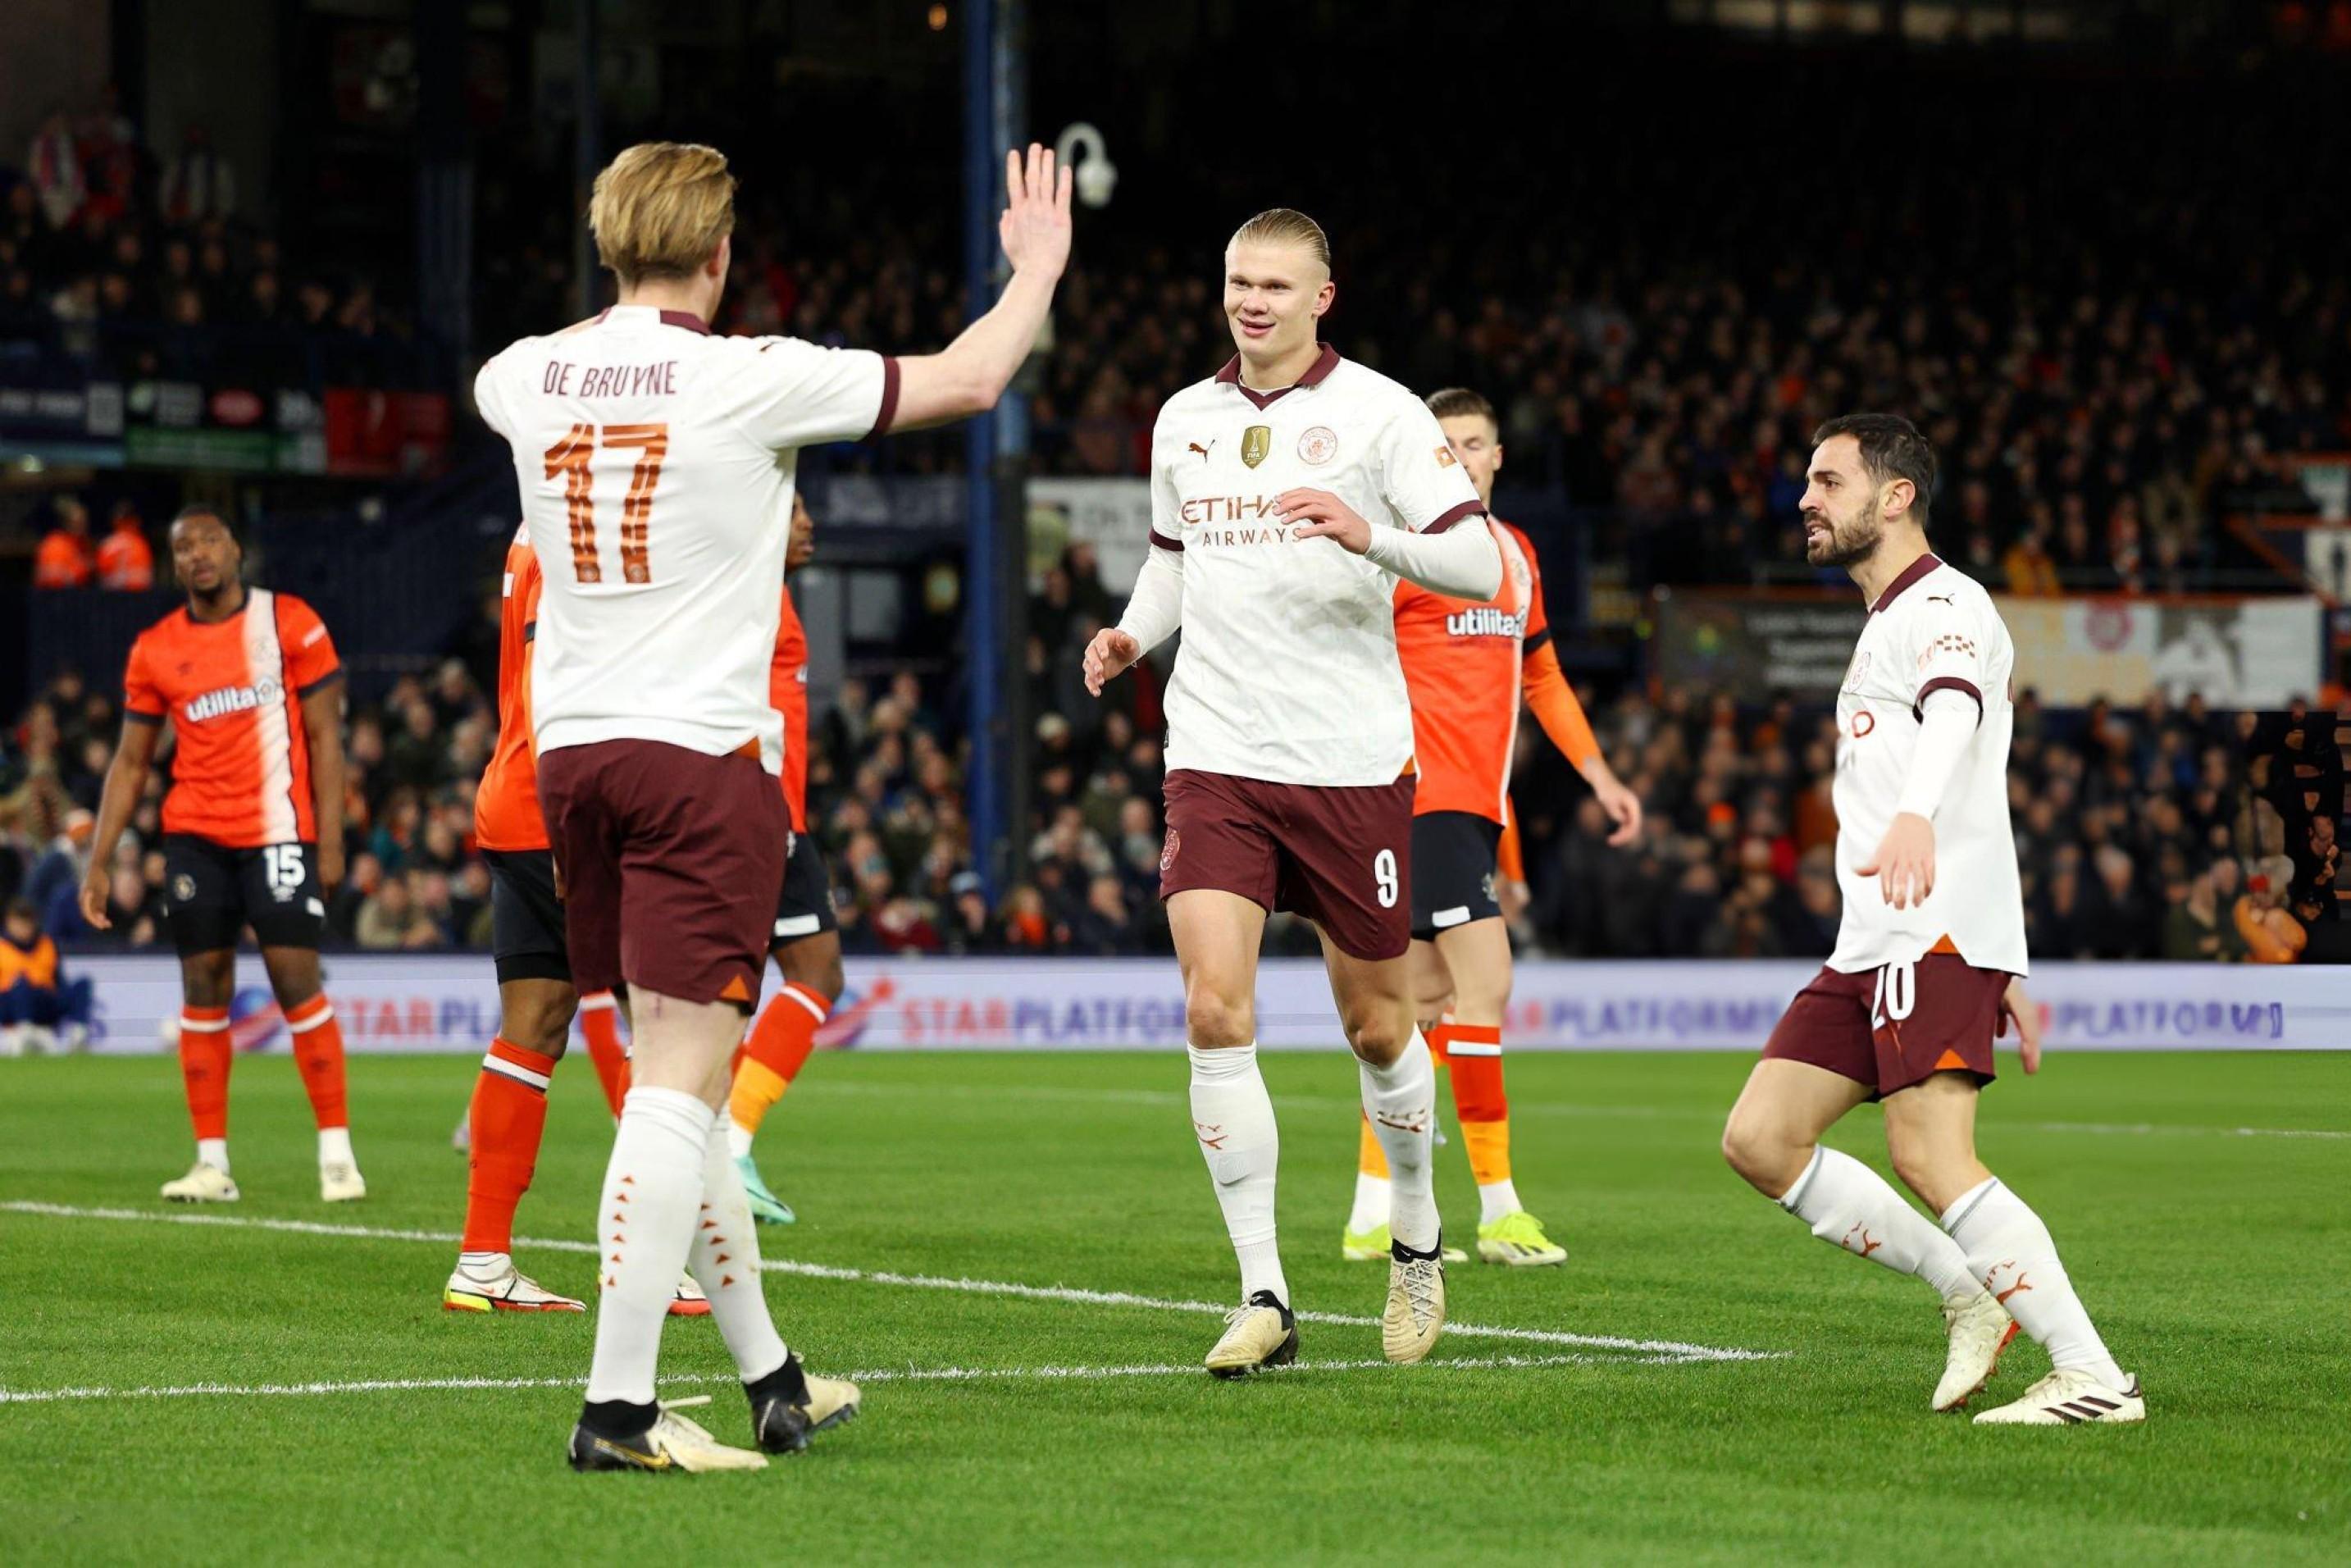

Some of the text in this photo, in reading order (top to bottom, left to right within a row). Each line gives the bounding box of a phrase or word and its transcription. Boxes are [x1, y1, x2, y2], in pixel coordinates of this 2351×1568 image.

[543, 360, 678, 397] DE BRUYNE
[544, 422, 668, 583] 17
[1447, 608, 1515, 636] utilita
[187, 686, 257, 722] utilita
[263, 843, 307, 889] 15
[1374, 848, 1398, 909] 9
[1870, 960, 1916, 1031] 20
